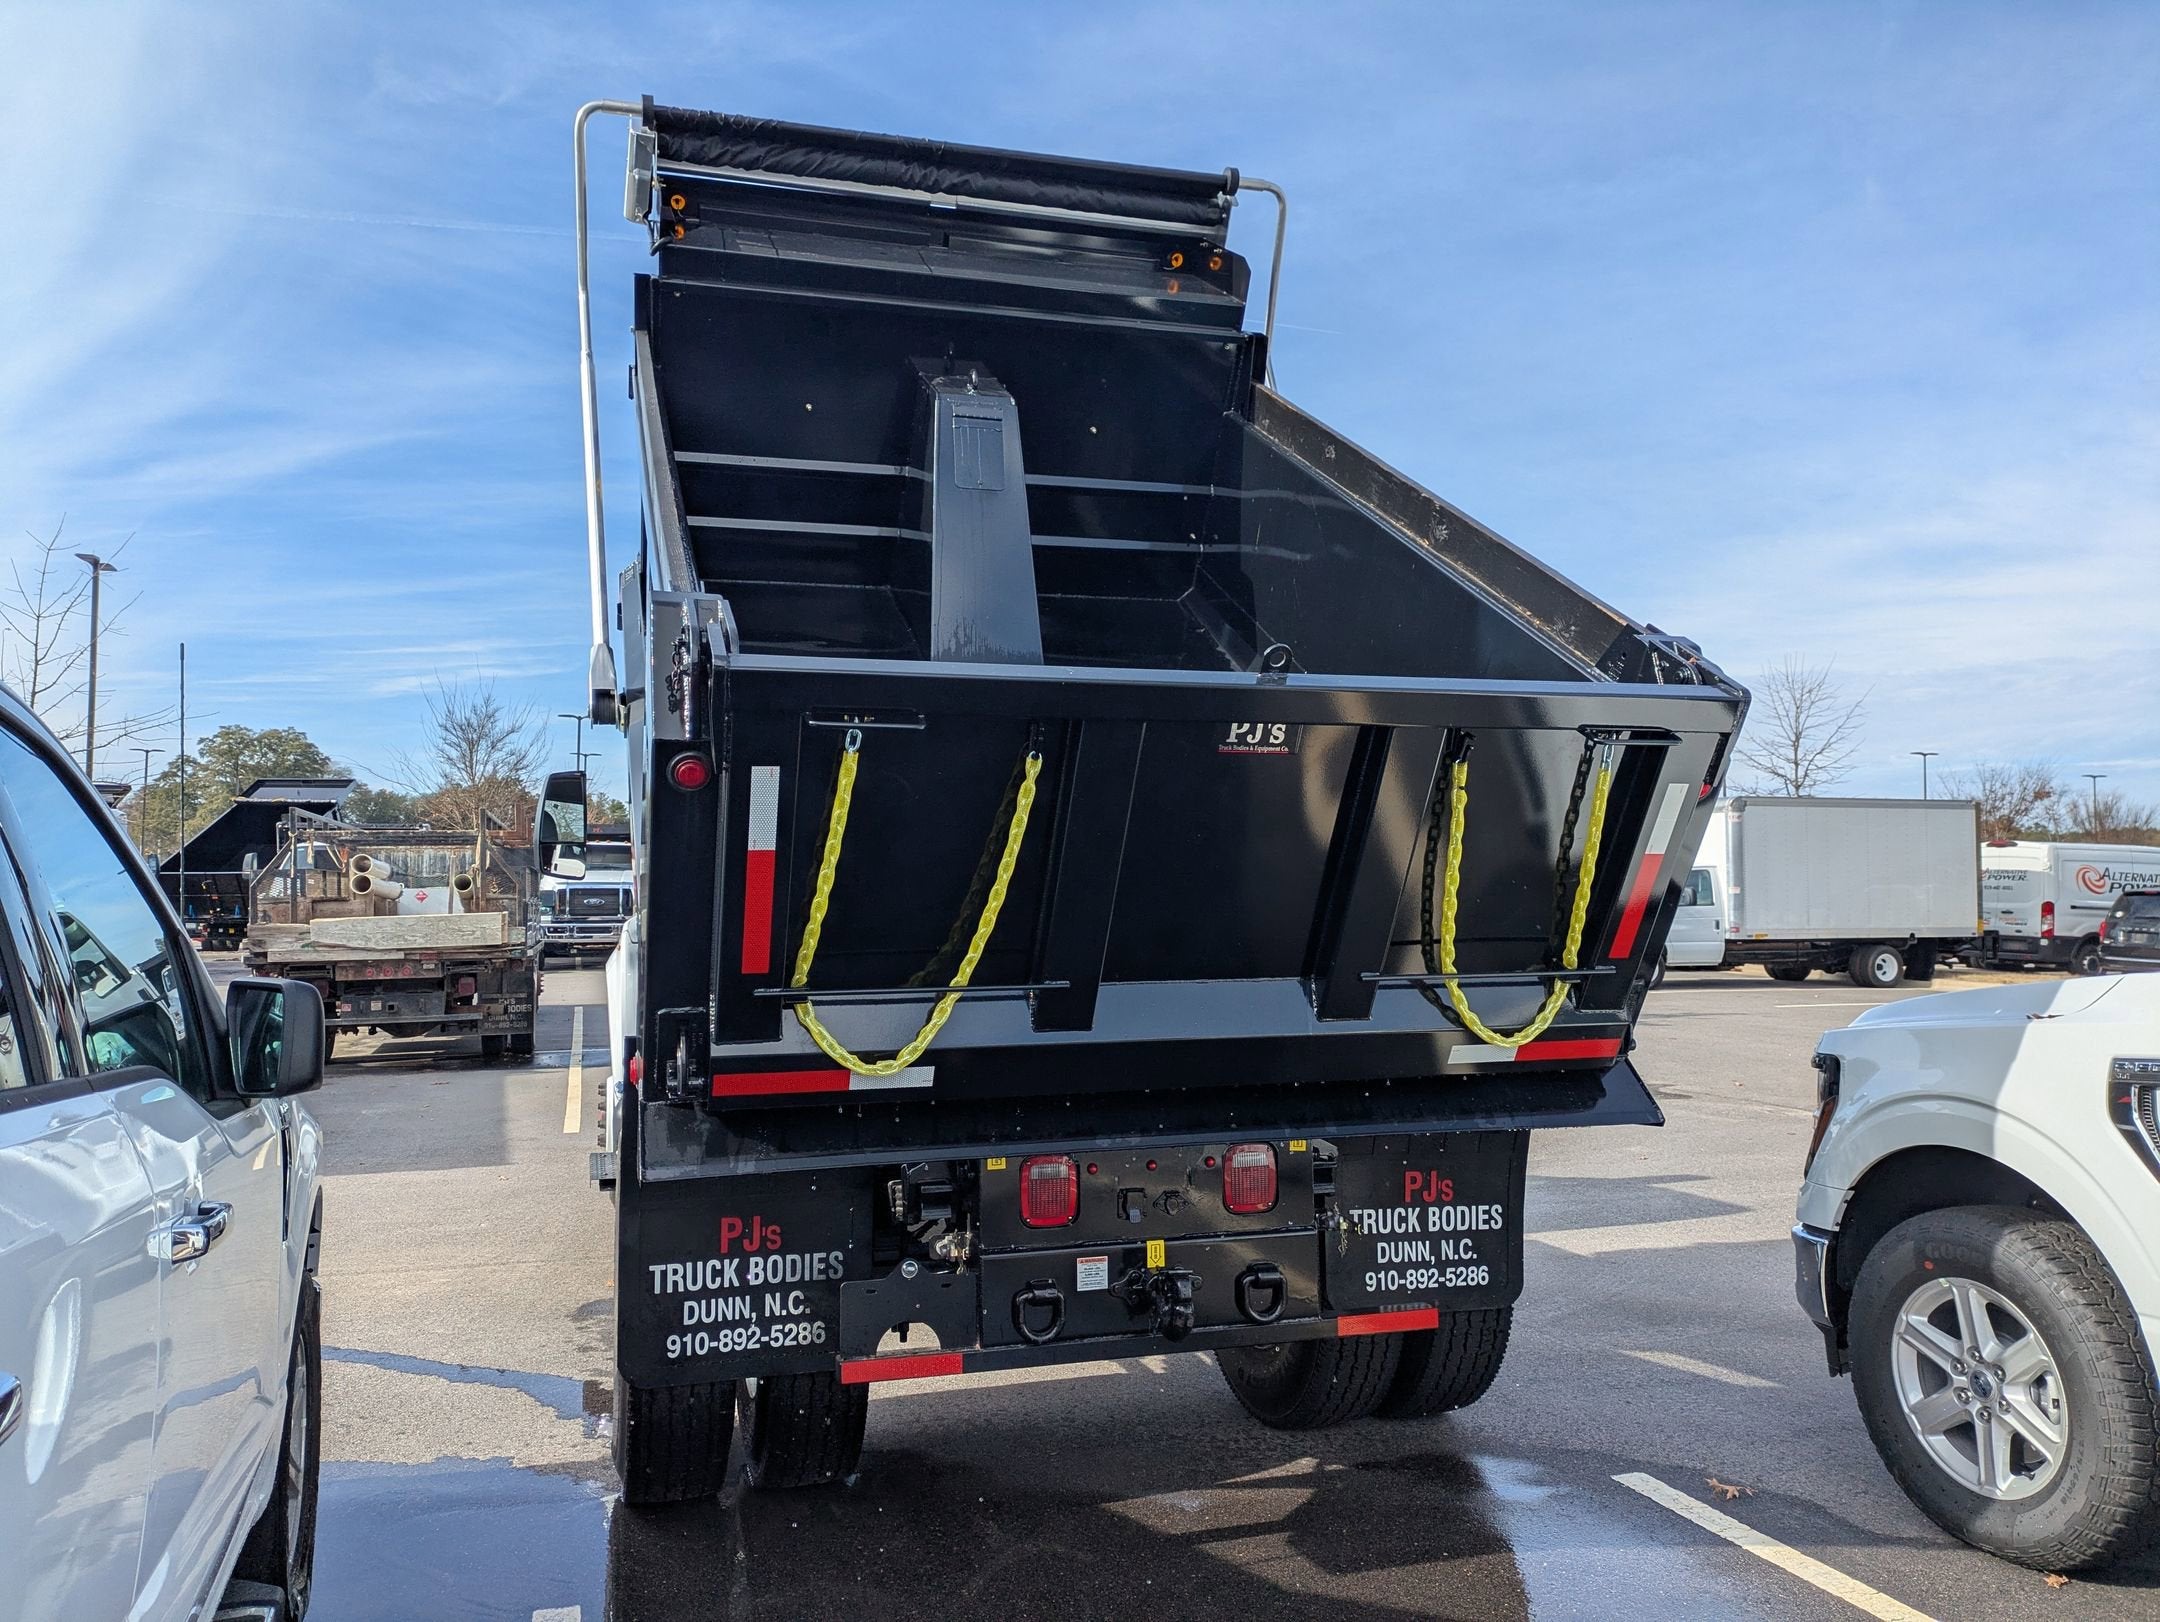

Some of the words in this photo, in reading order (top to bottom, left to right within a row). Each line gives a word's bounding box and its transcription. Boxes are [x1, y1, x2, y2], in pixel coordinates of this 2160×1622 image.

[1350, 1207, 1421, 1235] TRUCK
[1428, 1204, 1502, 1232] BODIES
[1377, 1240, 1435, 1265] DUNN,
[1441, 1238, 1478, 1261] N.C.
[649, 1258, 740, 1295] TRUCK
[749, 1251, 844, 1286] BODIES
[1365, 1265, 1489, 1292] 910-892-5286
[683, 1295, 757, 1325] DUNN,
[764, 1290, 811, 1318] N.C.
[666, 1320, 826, 1359] 910-892-5286
